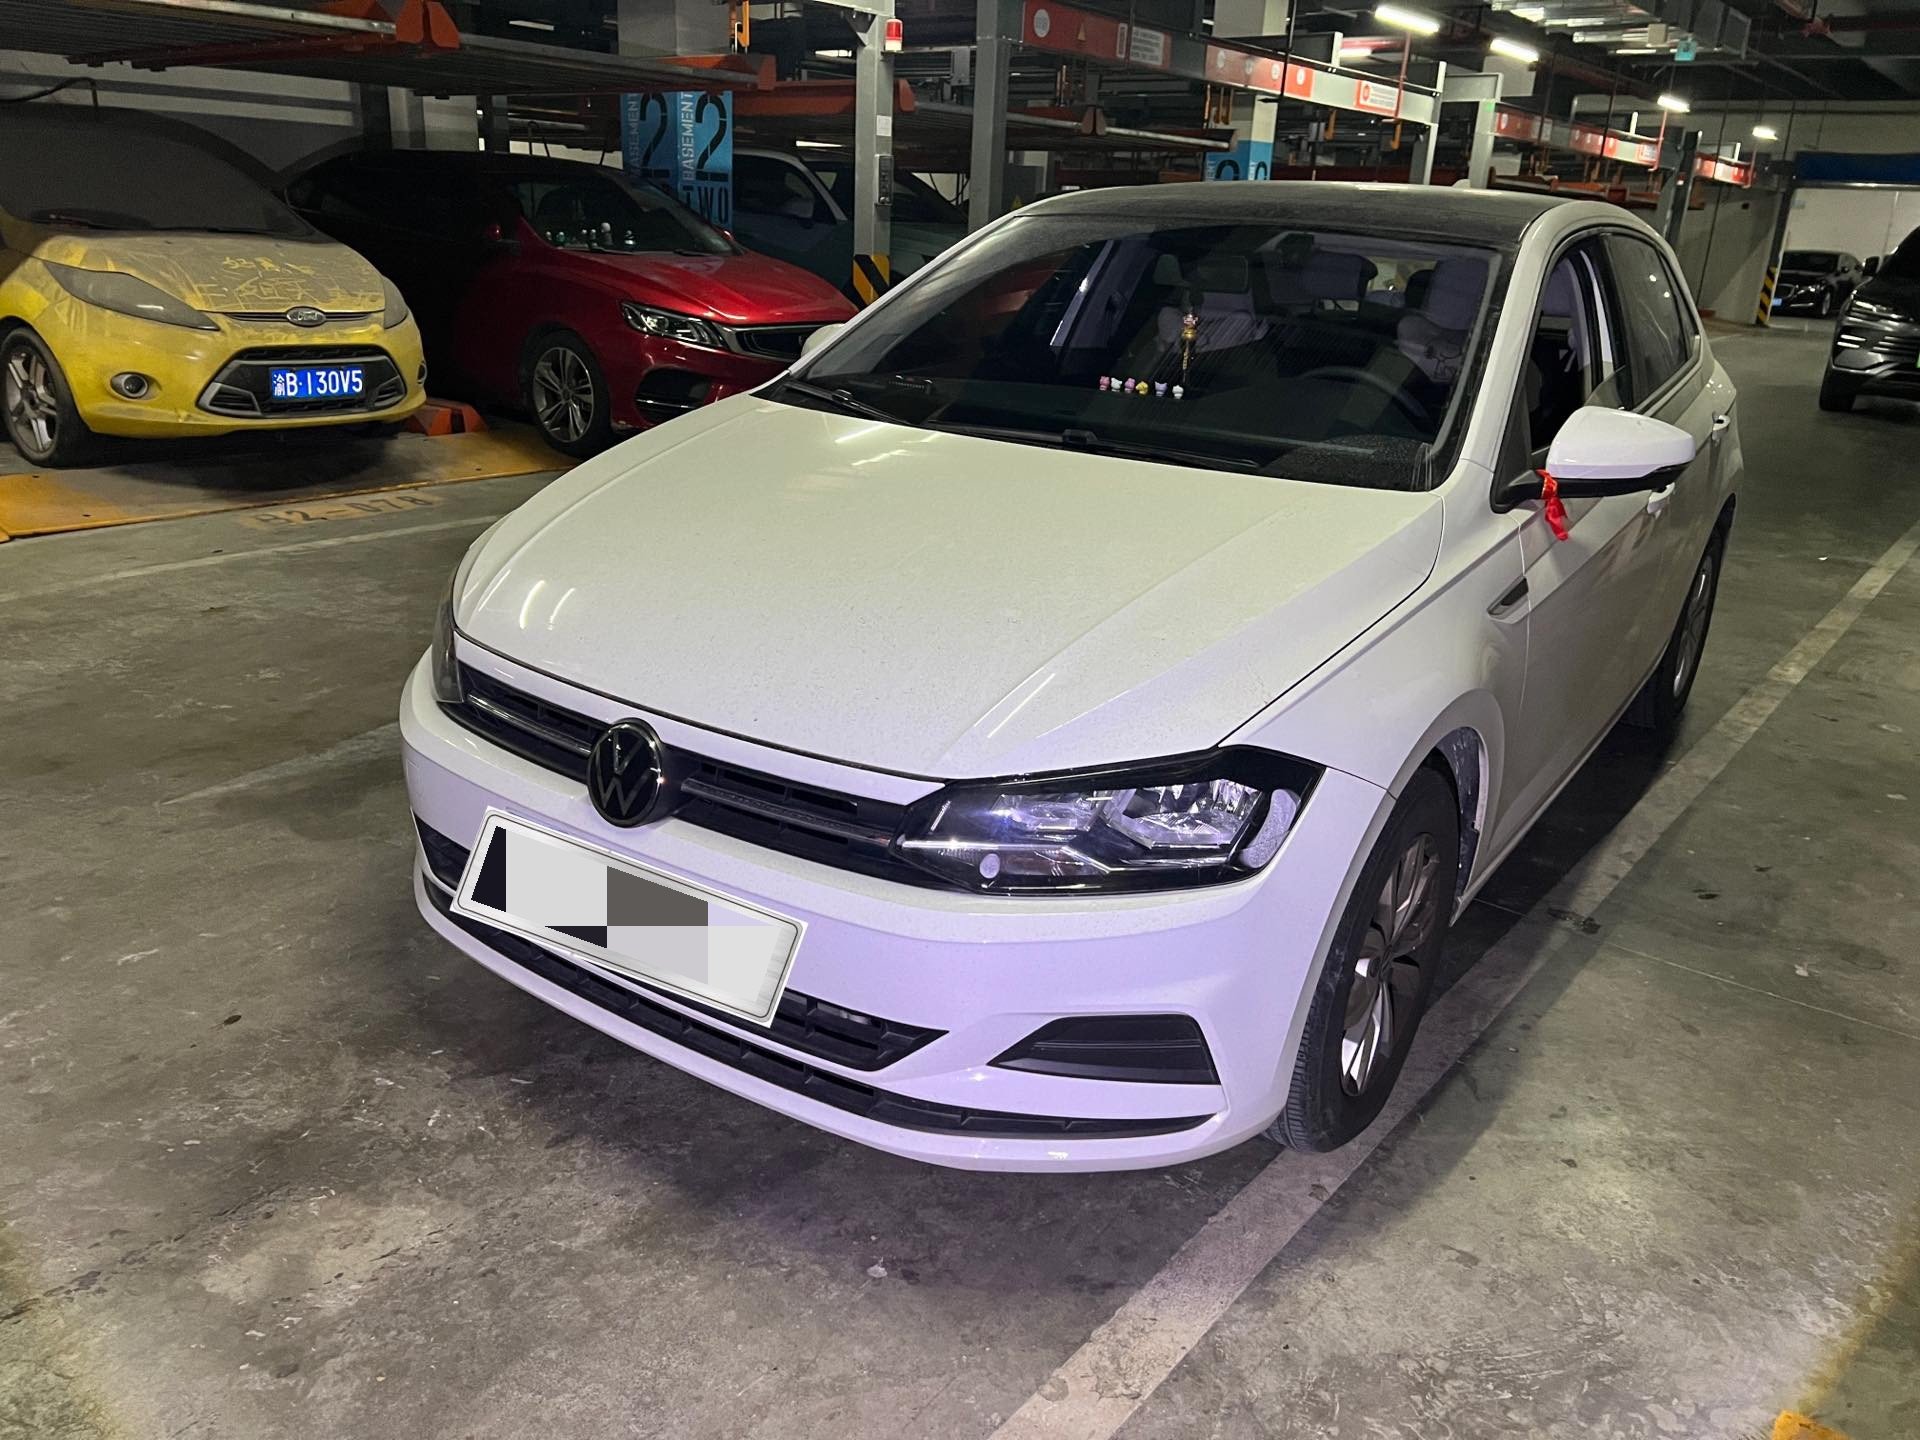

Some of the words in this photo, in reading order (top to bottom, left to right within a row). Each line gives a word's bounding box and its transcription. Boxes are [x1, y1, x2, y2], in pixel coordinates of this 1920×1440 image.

[640, 91, 670, 178] 2
[680, 91, 694, 181] BASEMENT
[695, 91, 729, 182] 2
[682, 185, 729, 224] TWO
